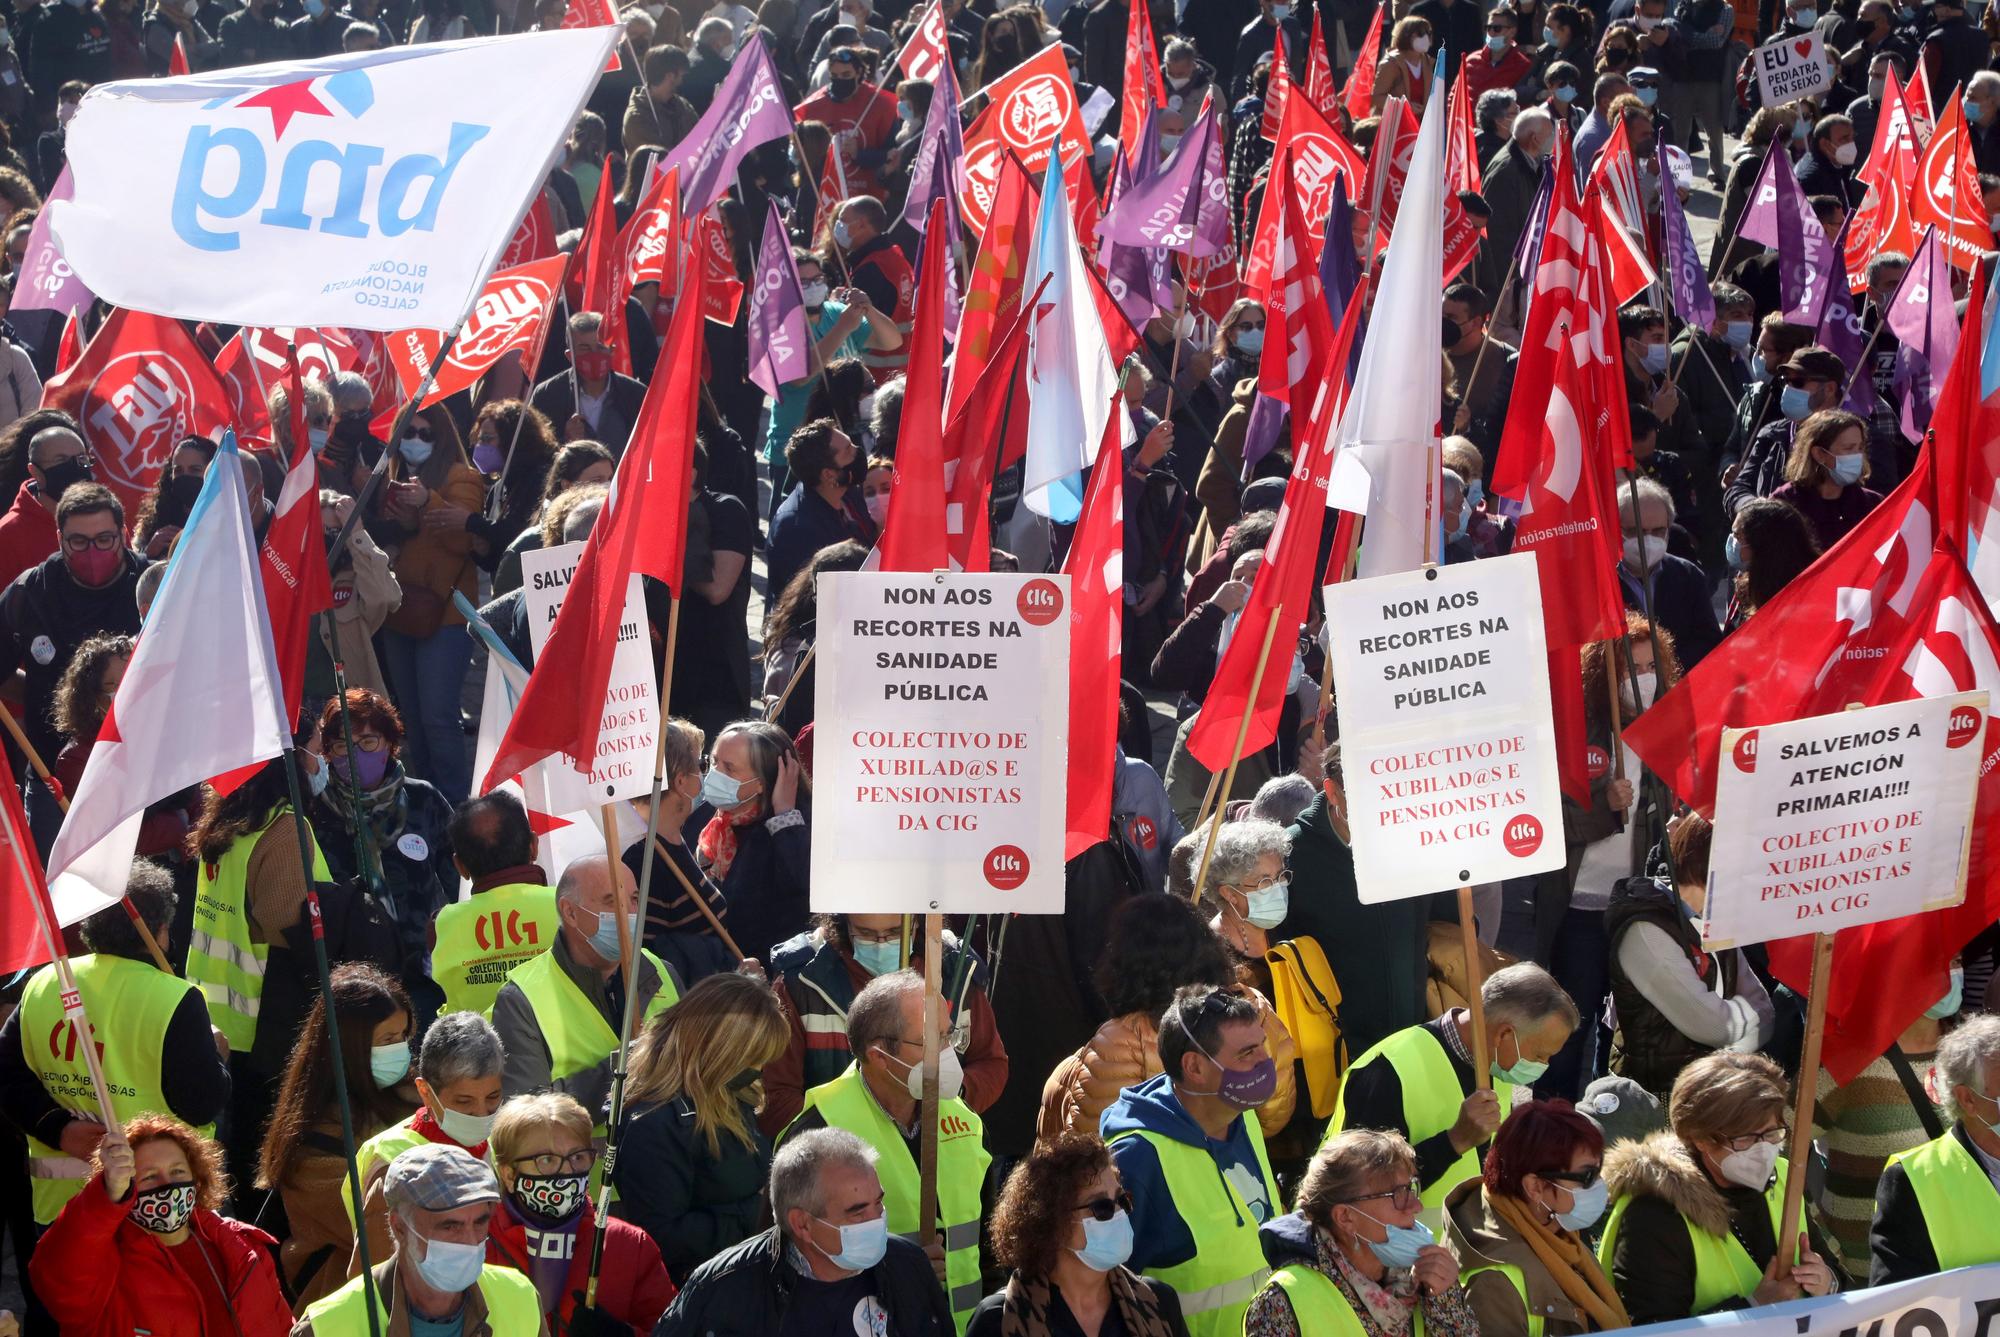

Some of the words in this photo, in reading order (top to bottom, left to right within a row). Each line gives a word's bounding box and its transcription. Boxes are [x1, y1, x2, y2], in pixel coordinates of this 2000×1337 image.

[1763, 46, 1789, 71] EU
[1768, 61, 1820, 86] PEDIATRA
[1773, 84, 1789, 98] EN
[1791, 73, 1822, 93] SEIXO
[1023, 138, 1080, 166] www.ut.es
[262, 535, 298, 589] ersindical
[884, 588, 936, 604] NON
[943, 588, 992, 605] AOS
[1026, 589, 1053, 606] CIG
[1382, 599, 1429, 620] NON
[1436, 591, 1479, 612] AOS
[853, 620, 981, 637] RECORTES
[989, 621, 1021, 637] NA
[1359, 622, 1472, 654] RECORTES
[1479, 616, 1509, 636] NA
[876, 652, 998, 670] SANIDADE
[1383, 649, 1491, 681] SANIDADE
[632, 682, 650, 699] DE
[884, 680, 988, 701] PÚBLICA
[1394, 680, 1487, 709] PÚBLICA
[639, 707, 648, 723] E
[852, 731, 991, 750] COLECTIVO
[998, 732, 1028, 750] DE
[1779, 727, 1900, 760] SALVEMOS
[1906, 723, 1921, 738] A
[1370, 740, 1493, 775] COLECTIVO
[1499, 736, 1526, 754] DE
[1588, 752, 1602, 765] IG
[588, 769, 607, 785] DA
[609, 762, 633, 779] CIG
[860, 759, 998, 781] XUBILAD@S
[1005, 760, 1018, 776] E
[1380, 766, 1502, 801] XUBILAD@S
[1508, 763, 1520, 779] E
[1790, 754, 1904, 787] ATENCIÓN
[856, 786, 1022, 803] PENSIONISTAS
[1379, 788, 1526, 826] PENSIONISTAS
[1777, 781, 1910, 817] PRIMARIA!!!!
[898, 814, 929, 832] DA
[936, 814, 978, 832] CIG
[1420, 828, 1448, 847] DA
[1454, 820, 1490, 841] CIG
[1510, 823, 1536, 841] CIG
[1762, 816, 1889, 853] COLECTIVO
[1895, 810, 1922, 829] DE
[993, 854, 1020, 871] CIG
[1766, 840, 1892, 877] XUBILAD@S
[1899, 837, 1912, 853] E
[1760, 861, 1912, 901] PENSIONISTAS
[1796, 904, 1824, 920] DA
[1830, 893, 1869, 913] CIG
[475, 909, 539, 951] CIG
[469, 960, 507, 974] COLECTIVO
[940, 1115, 970, 1135] CIG
